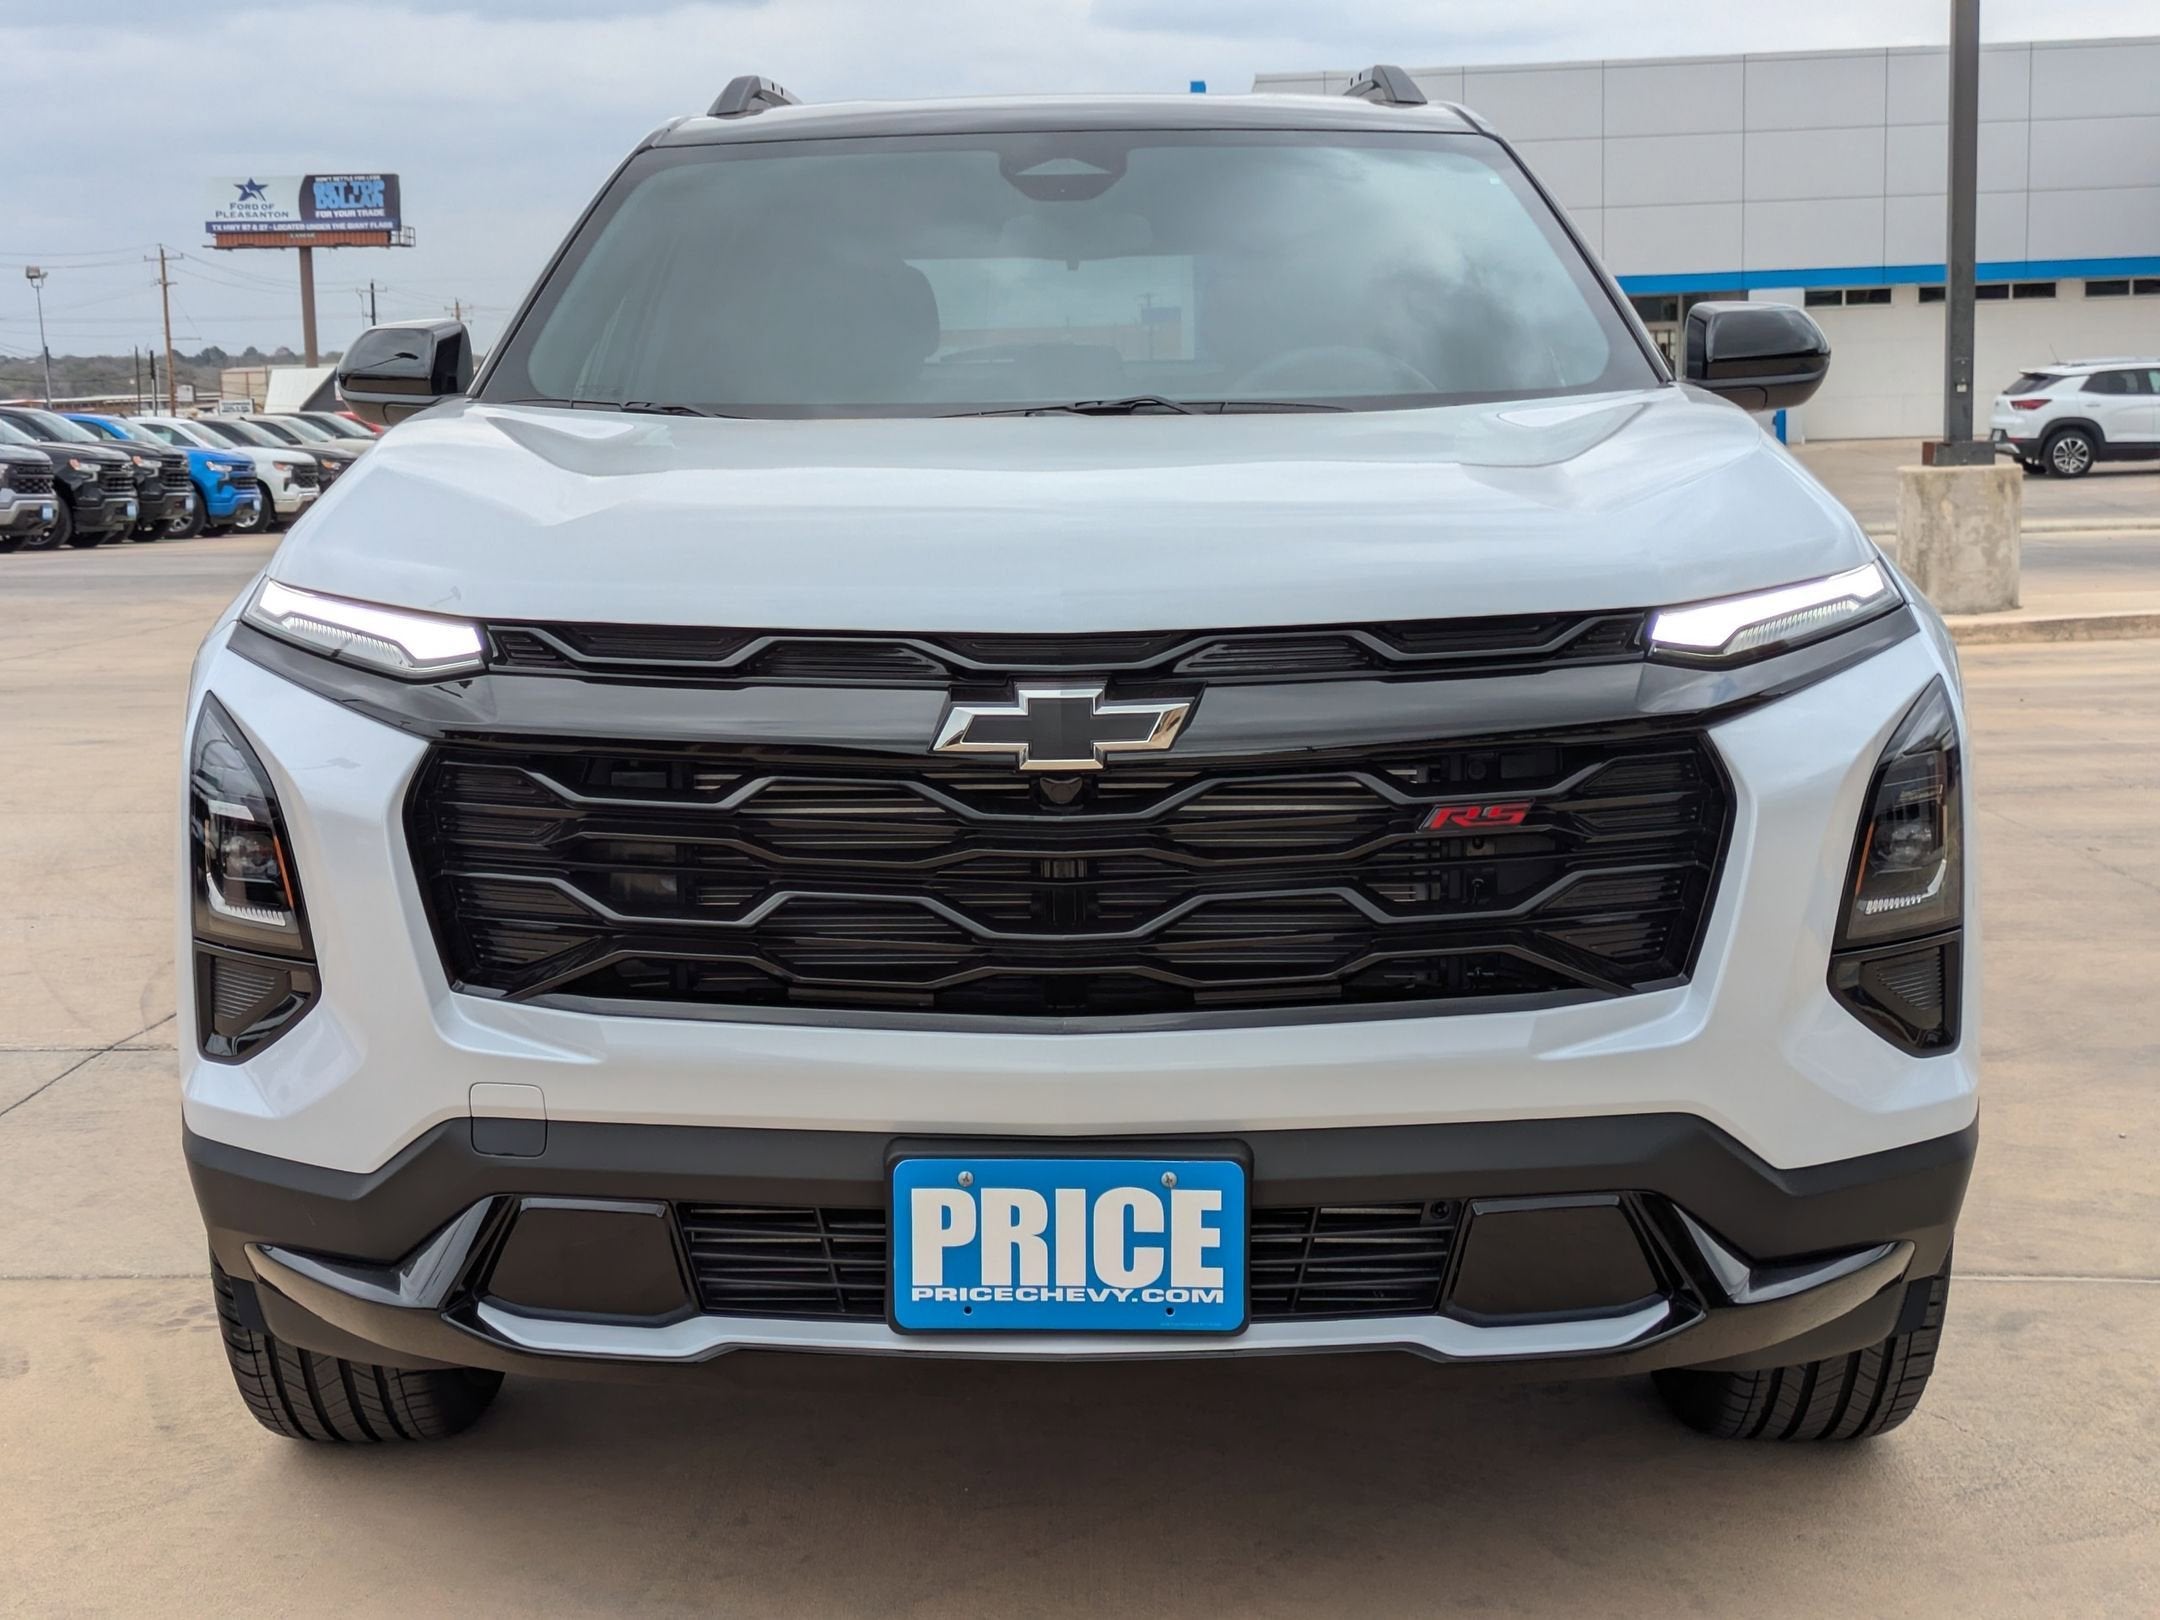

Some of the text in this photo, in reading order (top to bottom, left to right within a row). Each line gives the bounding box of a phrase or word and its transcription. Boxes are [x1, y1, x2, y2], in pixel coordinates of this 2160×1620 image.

[261, 202, 275, 210] OF
[215, 210, 289, 219] PLEASANTON
[315, 208, 385, 218] FOR YOUR TRADE
[273, 223, 305, 231] LOCATED
[347, 222, 368, 230] GIANT
[369, 221, 393, 229] FLAGS
[1422, 801, 1533, 829] RS
[912, 1187, 1224, 1289] PRICE
[912, 1287, 1224, 1303] PRICECHEVY.COM
